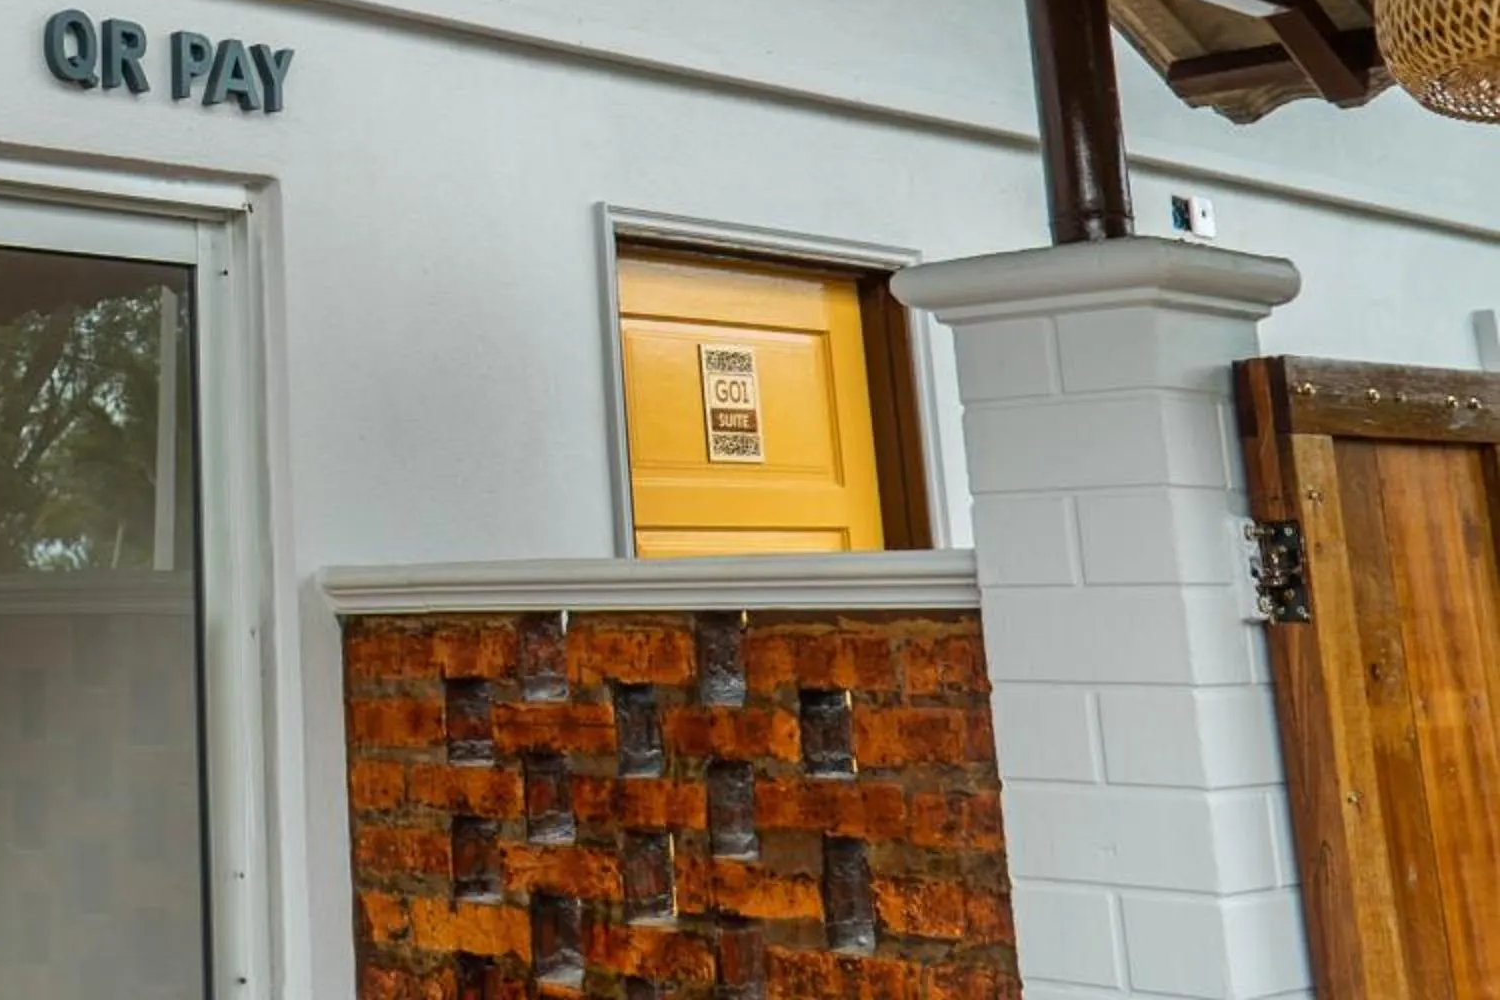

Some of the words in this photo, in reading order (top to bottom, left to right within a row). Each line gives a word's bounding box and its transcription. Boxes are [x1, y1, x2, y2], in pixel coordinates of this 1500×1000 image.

[43, 8, 151, 94] QR
[170, 30, 295, 114] PAY
[718, 412, 749, 429] SUITE
